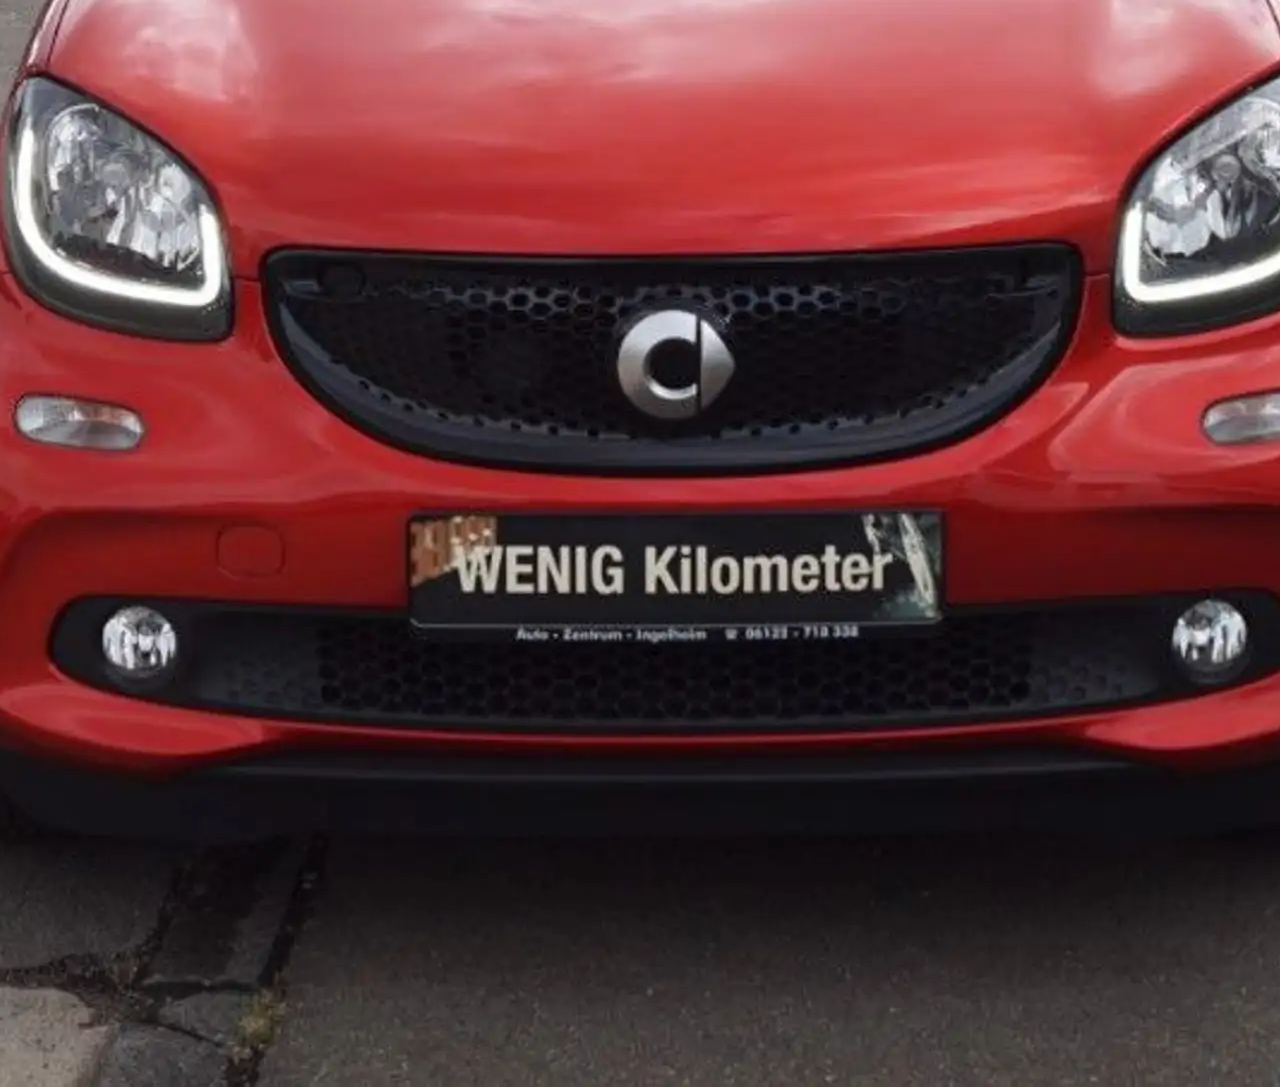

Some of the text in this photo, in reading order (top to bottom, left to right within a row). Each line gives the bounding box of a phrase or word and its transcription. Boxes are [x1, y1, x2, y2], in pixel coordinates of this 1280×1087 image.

[456, 544, 893, 594] WENIG Kilometer
[517, 627, 549, 641] Auto
[563, 628, 623, 641] Zentrum
[637, 627, 707, 643] Ingelheim
